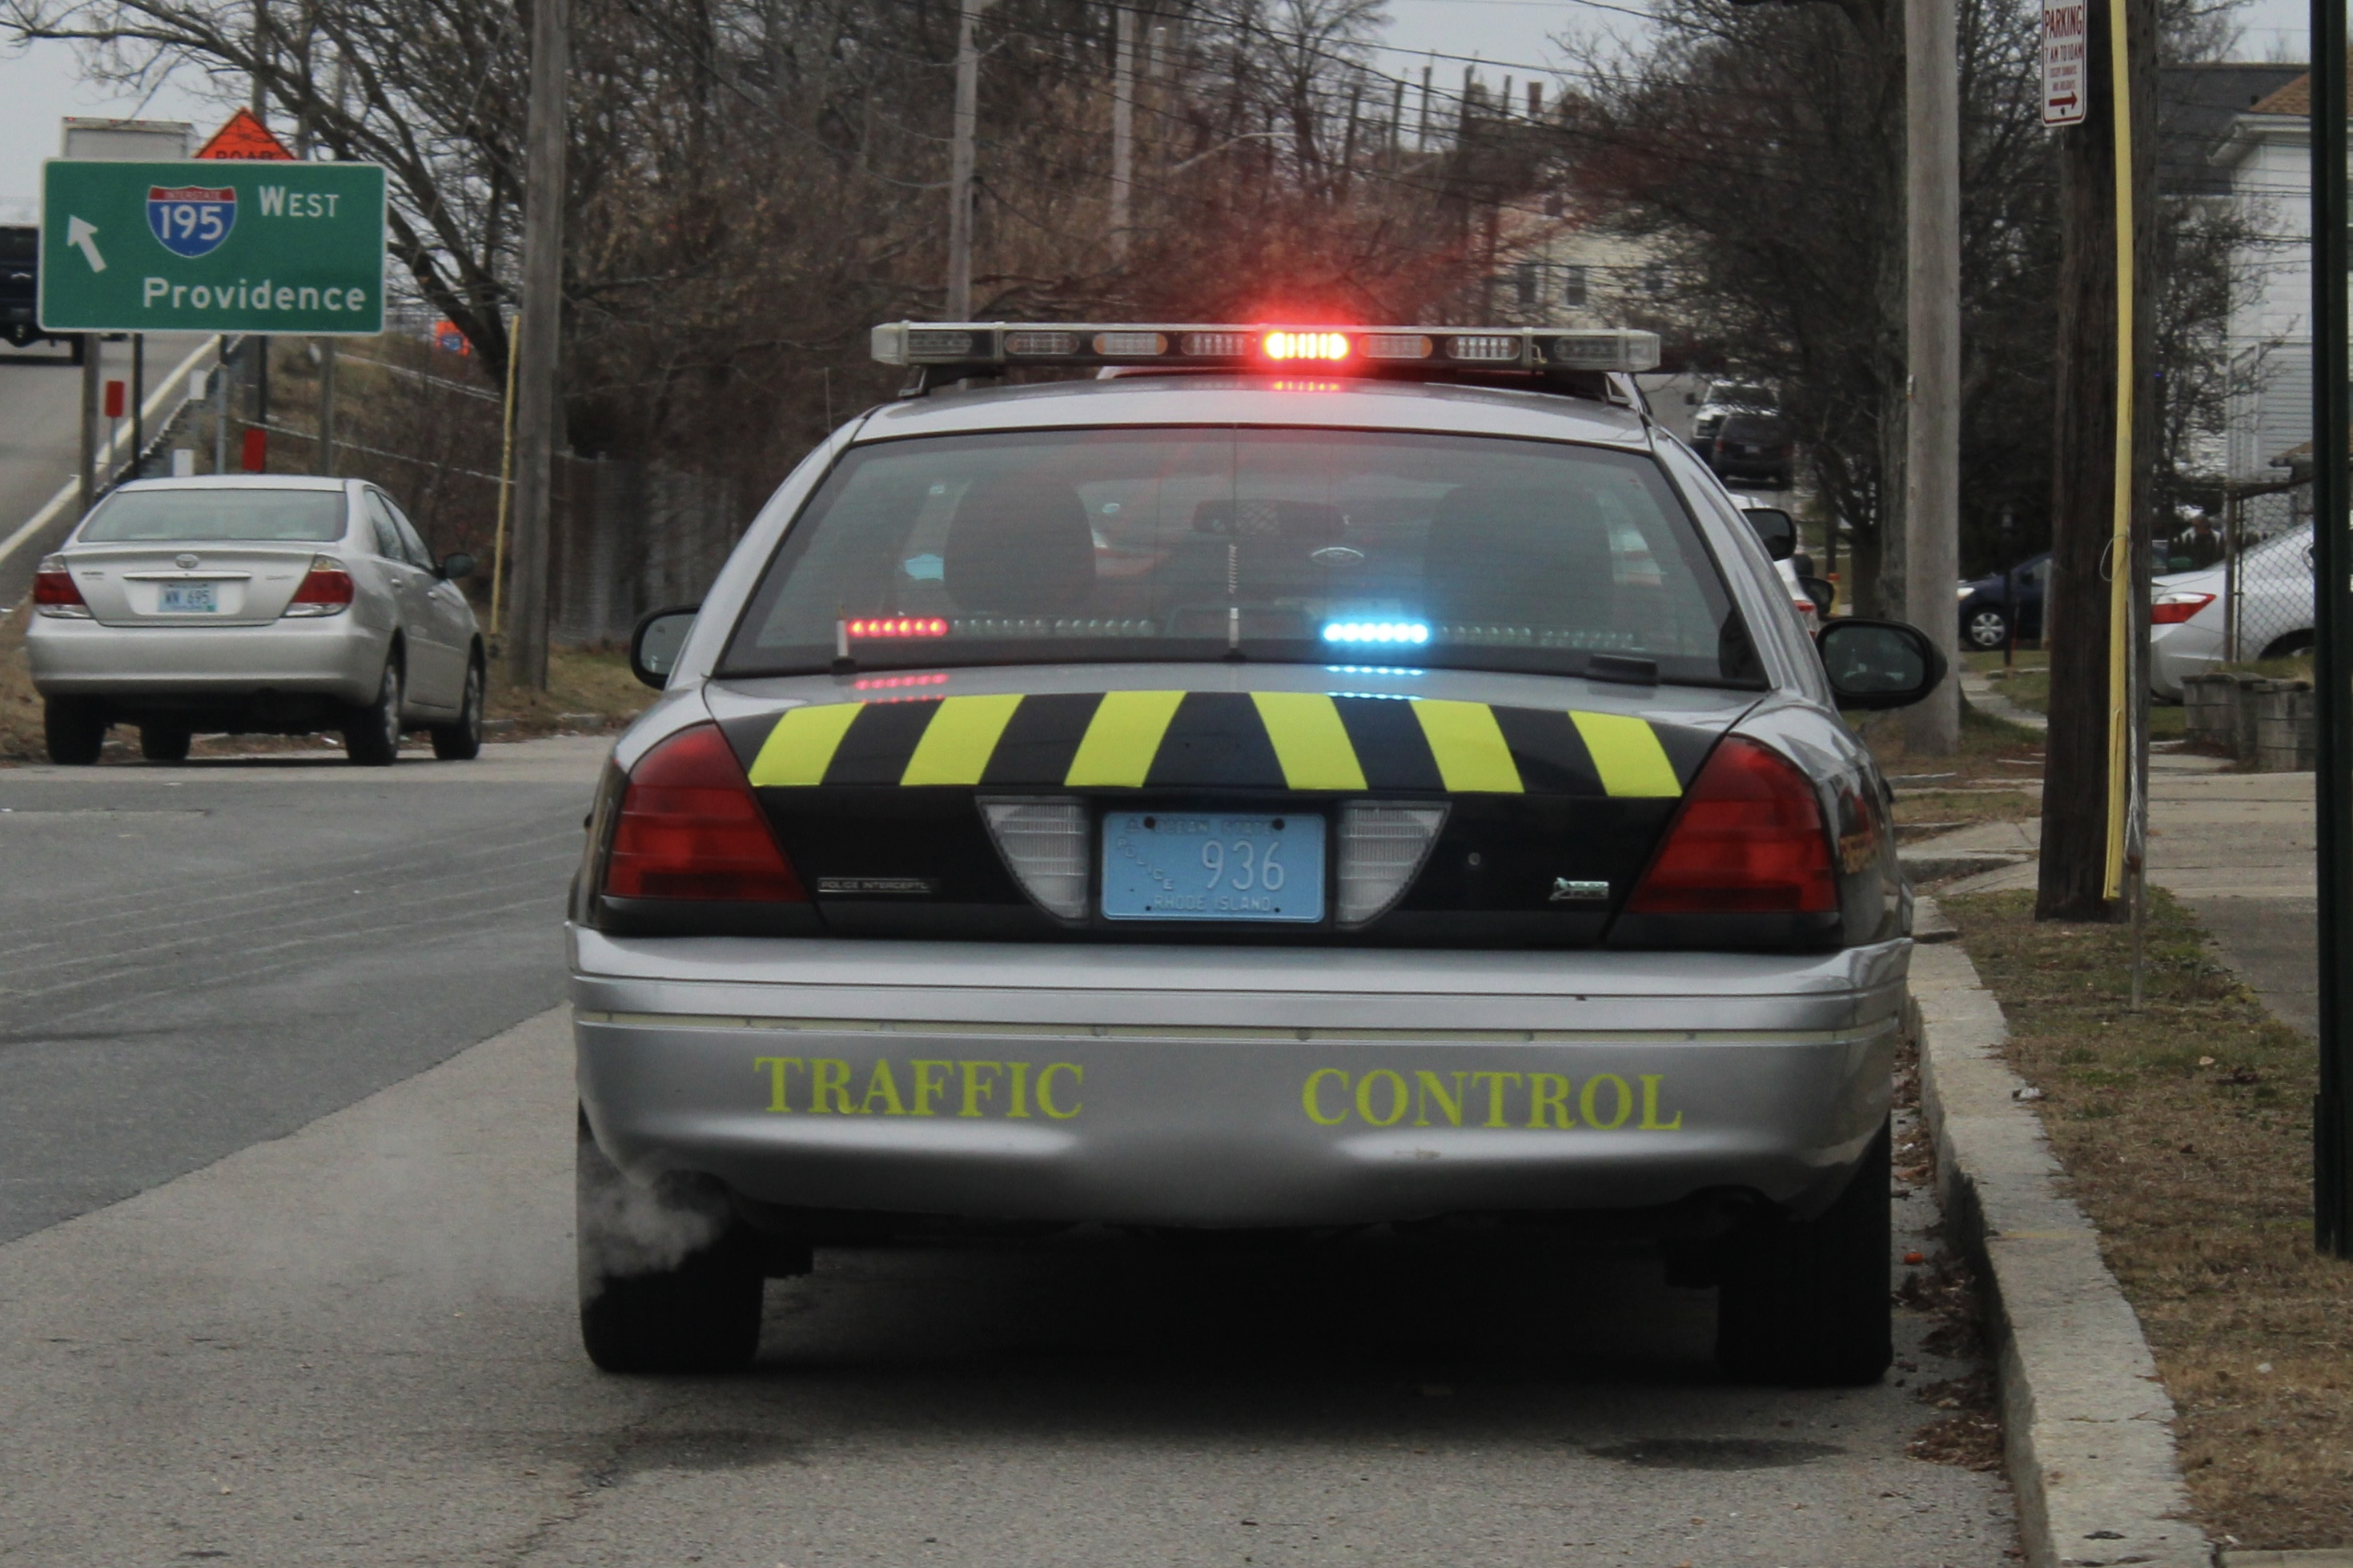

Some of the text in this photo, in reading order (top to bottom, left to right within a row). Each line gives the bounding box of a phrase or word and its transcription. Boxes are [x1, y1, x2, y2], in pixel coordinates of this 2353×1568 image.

[2045, 6, 2082, 39] PARKING
[164, 190, 221, 201] INTERSTATE
[160, 205, 223, 240] 195
[143, 277, 366, 311] Providence
[1117, 839, 1174, 891] POLICE
[1203, 840, 1284, 891] 936
[821, 881, 859, 889] POLICE
[1154, 896, 1271, 912] RHODE ISLAND
[753, 1057, 1084, 1119] TRAFFIC
[1302, 1068, 1682, 1131] CONTROL
